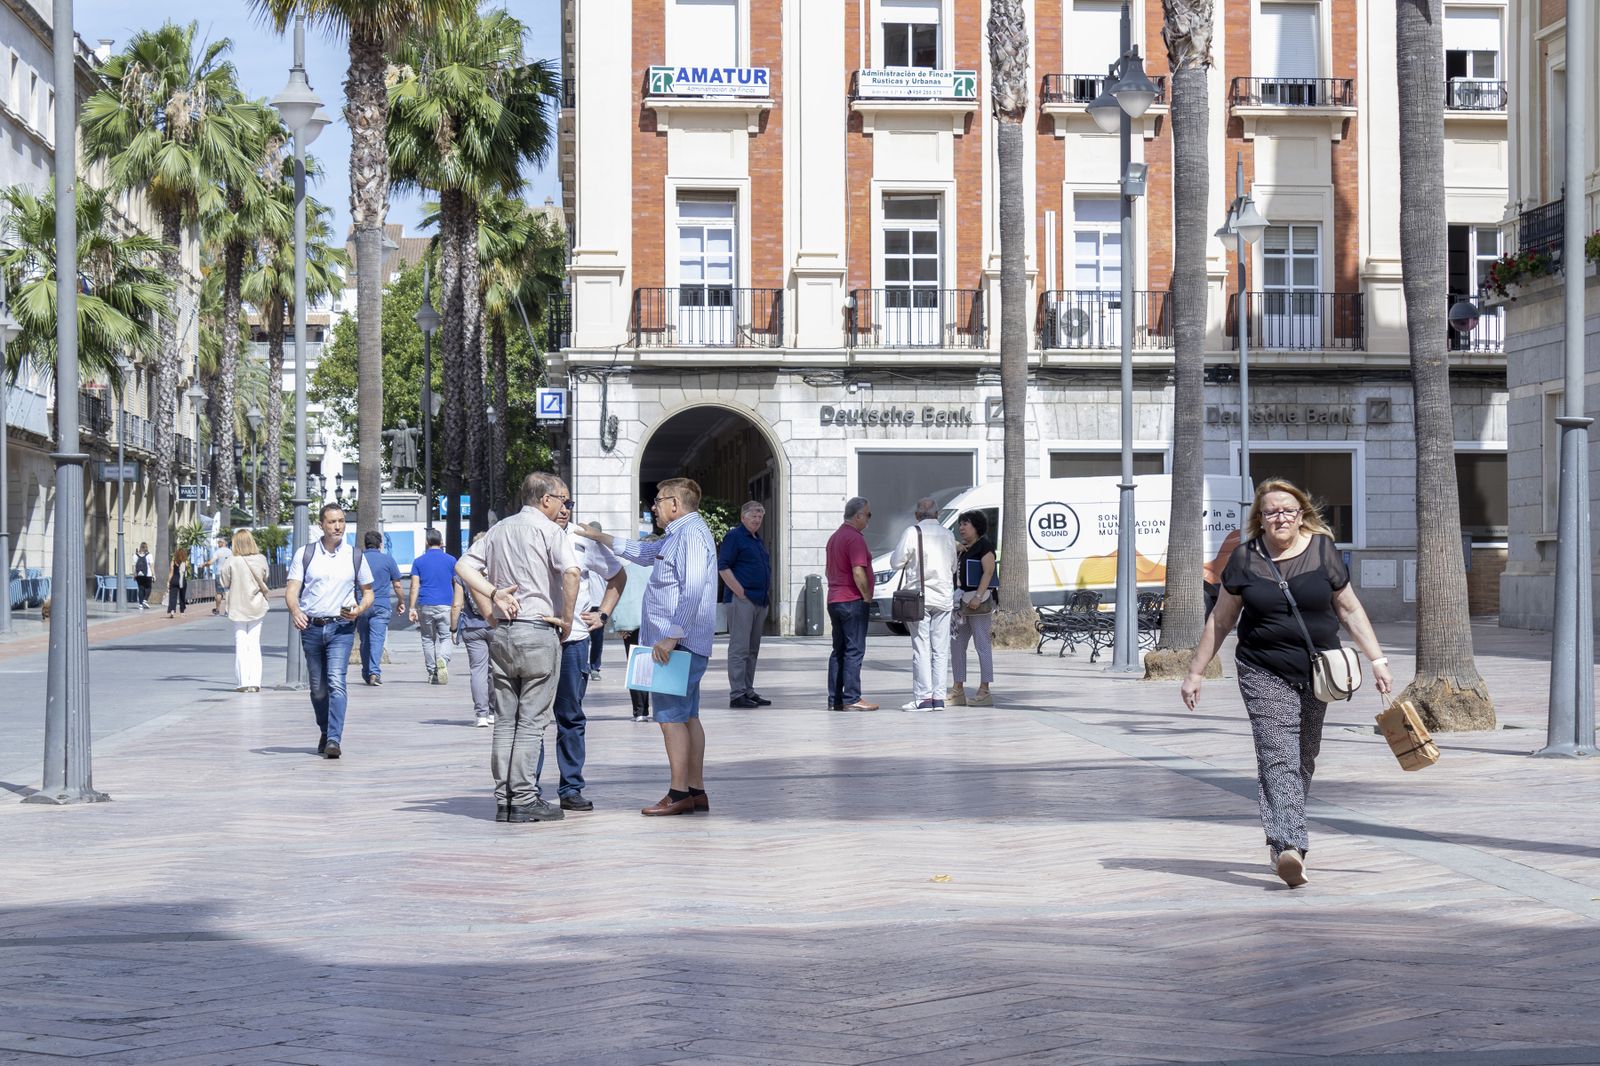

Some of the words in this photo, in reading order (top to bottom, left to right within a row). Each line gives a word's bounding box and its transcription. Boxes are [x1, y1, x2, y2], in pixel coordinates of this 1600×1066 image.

[676, 67, 767, 84] AMATUR
[820, 405, 915, 426] Deutsche
[922, 405, 973, 426] Bank
[1306, 407, 1353, 423] Bank
[1038, 513, 1068, 530] dB
[1098, 519, 1166, 528] ILUMACIÓN
[1098, 528, 1161, 536] MULEDIA
